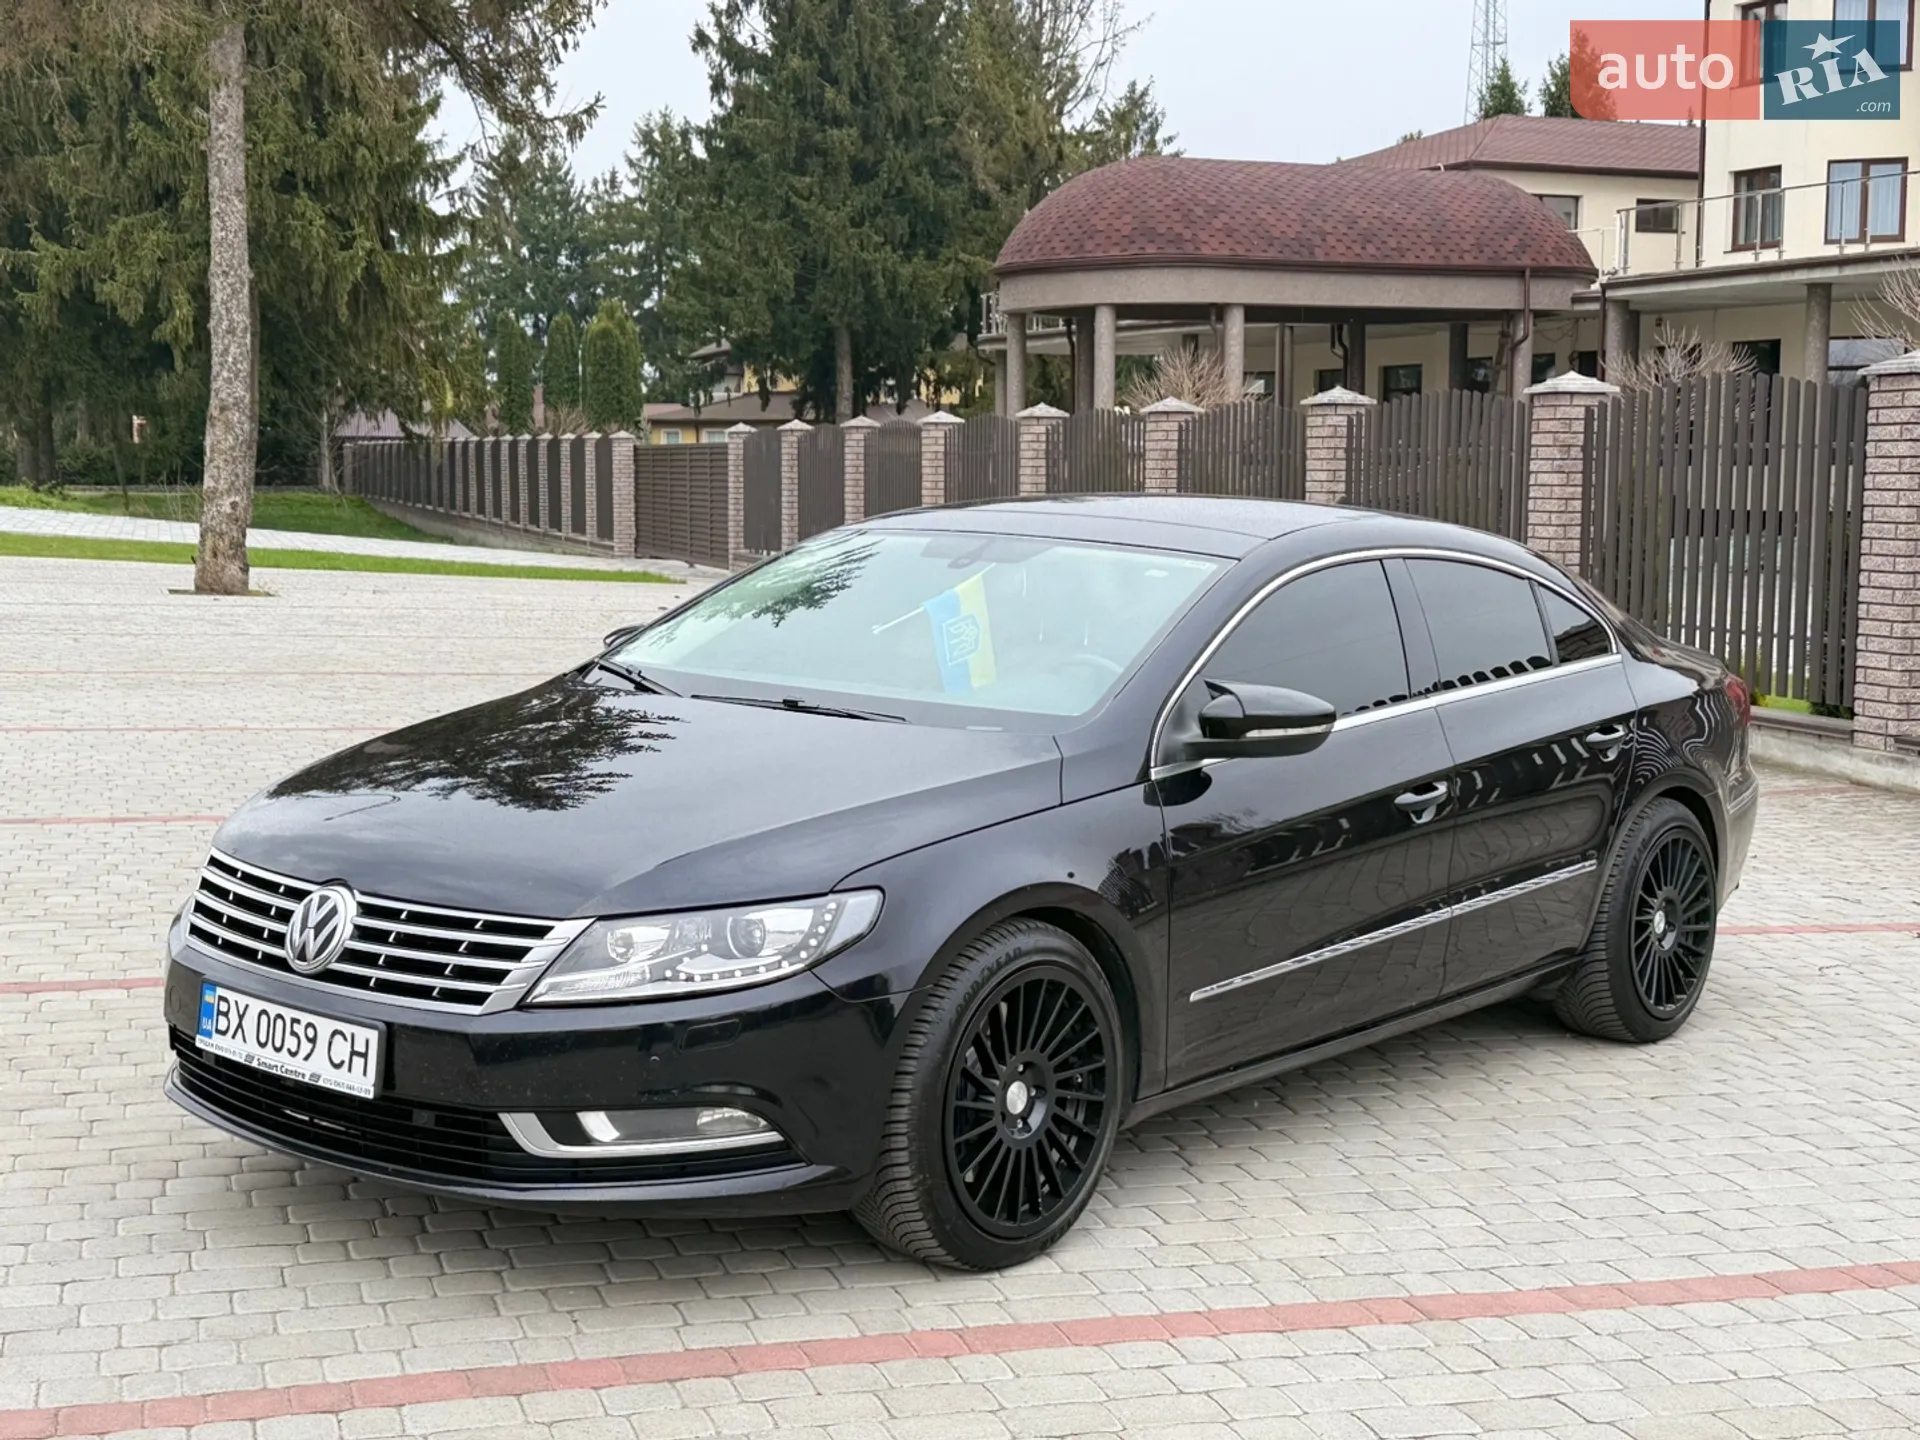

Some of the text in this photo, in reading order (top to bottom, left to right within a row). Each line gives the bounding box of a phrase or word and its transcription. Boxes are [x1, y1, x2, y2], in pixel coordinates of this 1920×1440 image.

[202, 1017, 212, 1031] UA
[216, 995, 250, 1044] BX
[255, 1008, 318, 1062] 0059
[328, 1028, 369, 1077] CH
[256, 1057, 306, 1080] Smart Centre
